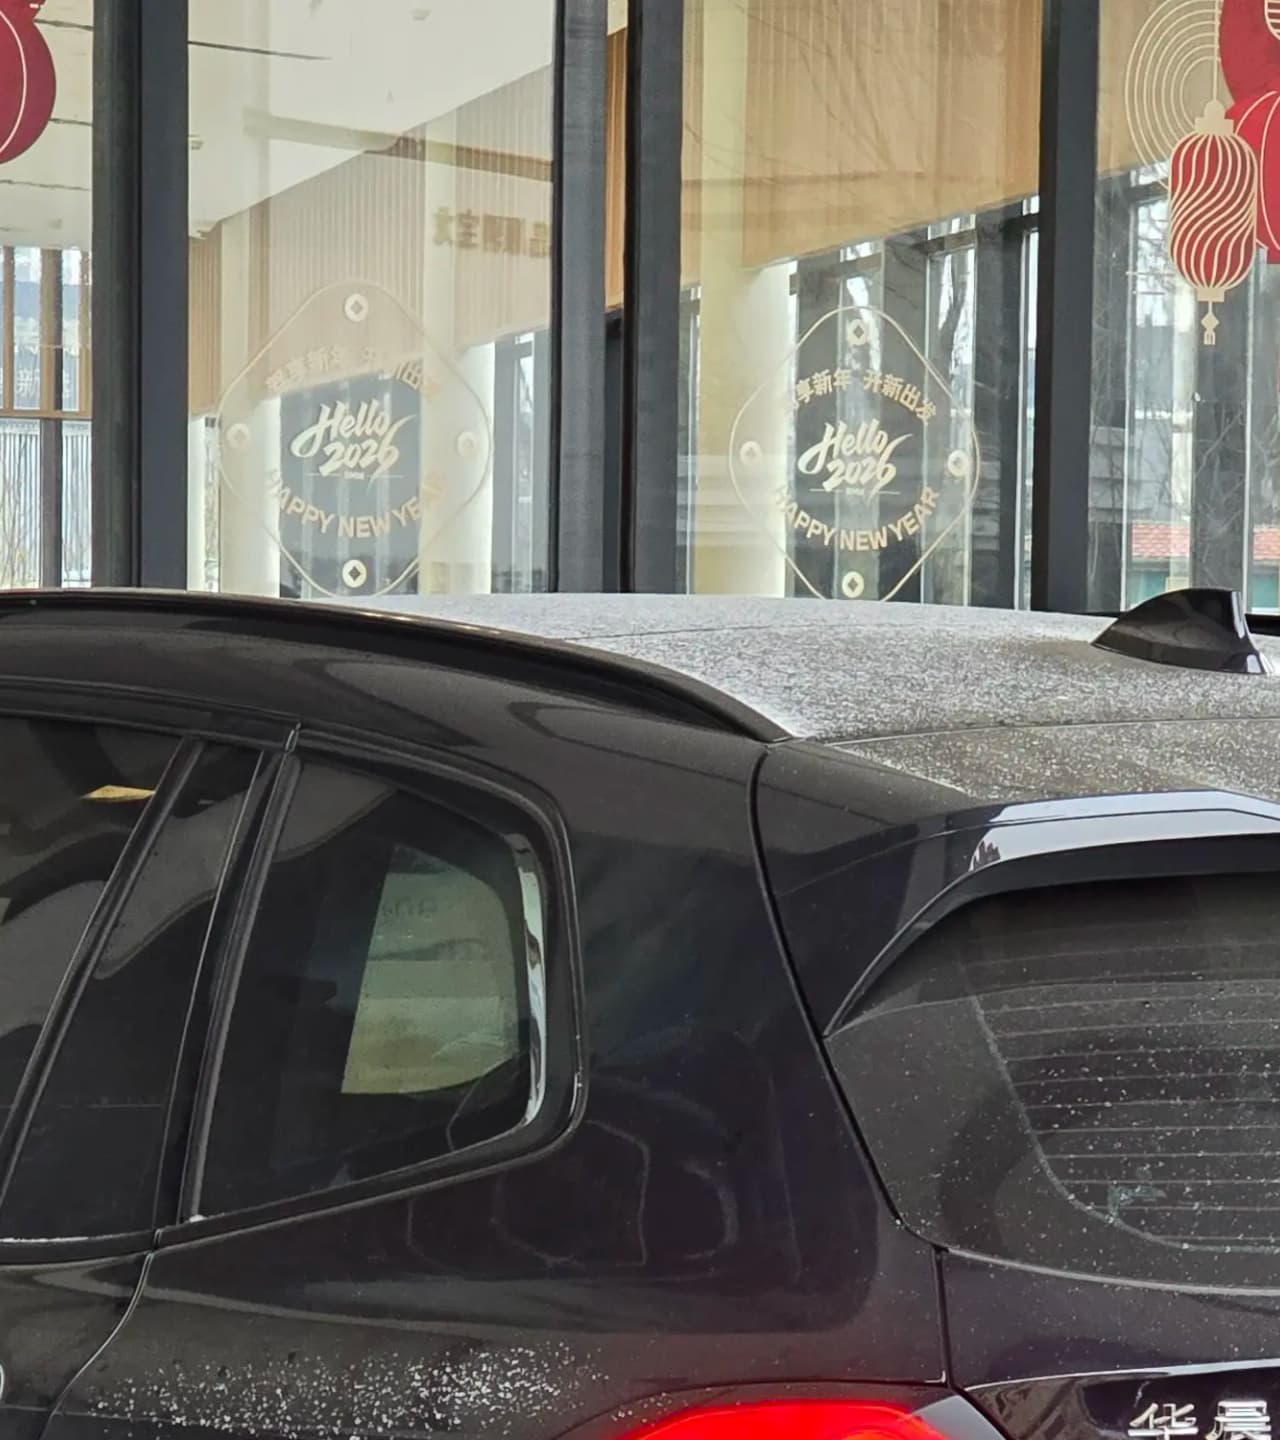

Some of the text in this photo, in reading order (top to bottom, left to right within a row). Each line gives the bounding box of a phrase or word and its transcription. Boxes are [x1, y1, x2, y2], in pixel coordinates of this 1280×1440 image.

[291, 399, 392, 458] Hello
[319, 415, 417, 490] 2026
[797, 418, 889, 474] Hello
[822, 434, 913, 500] 2026
[337, 515, 392, 538] NEW
[840, 530, 888, 551] NEW
[888, 486, 940, 541] YEAR
